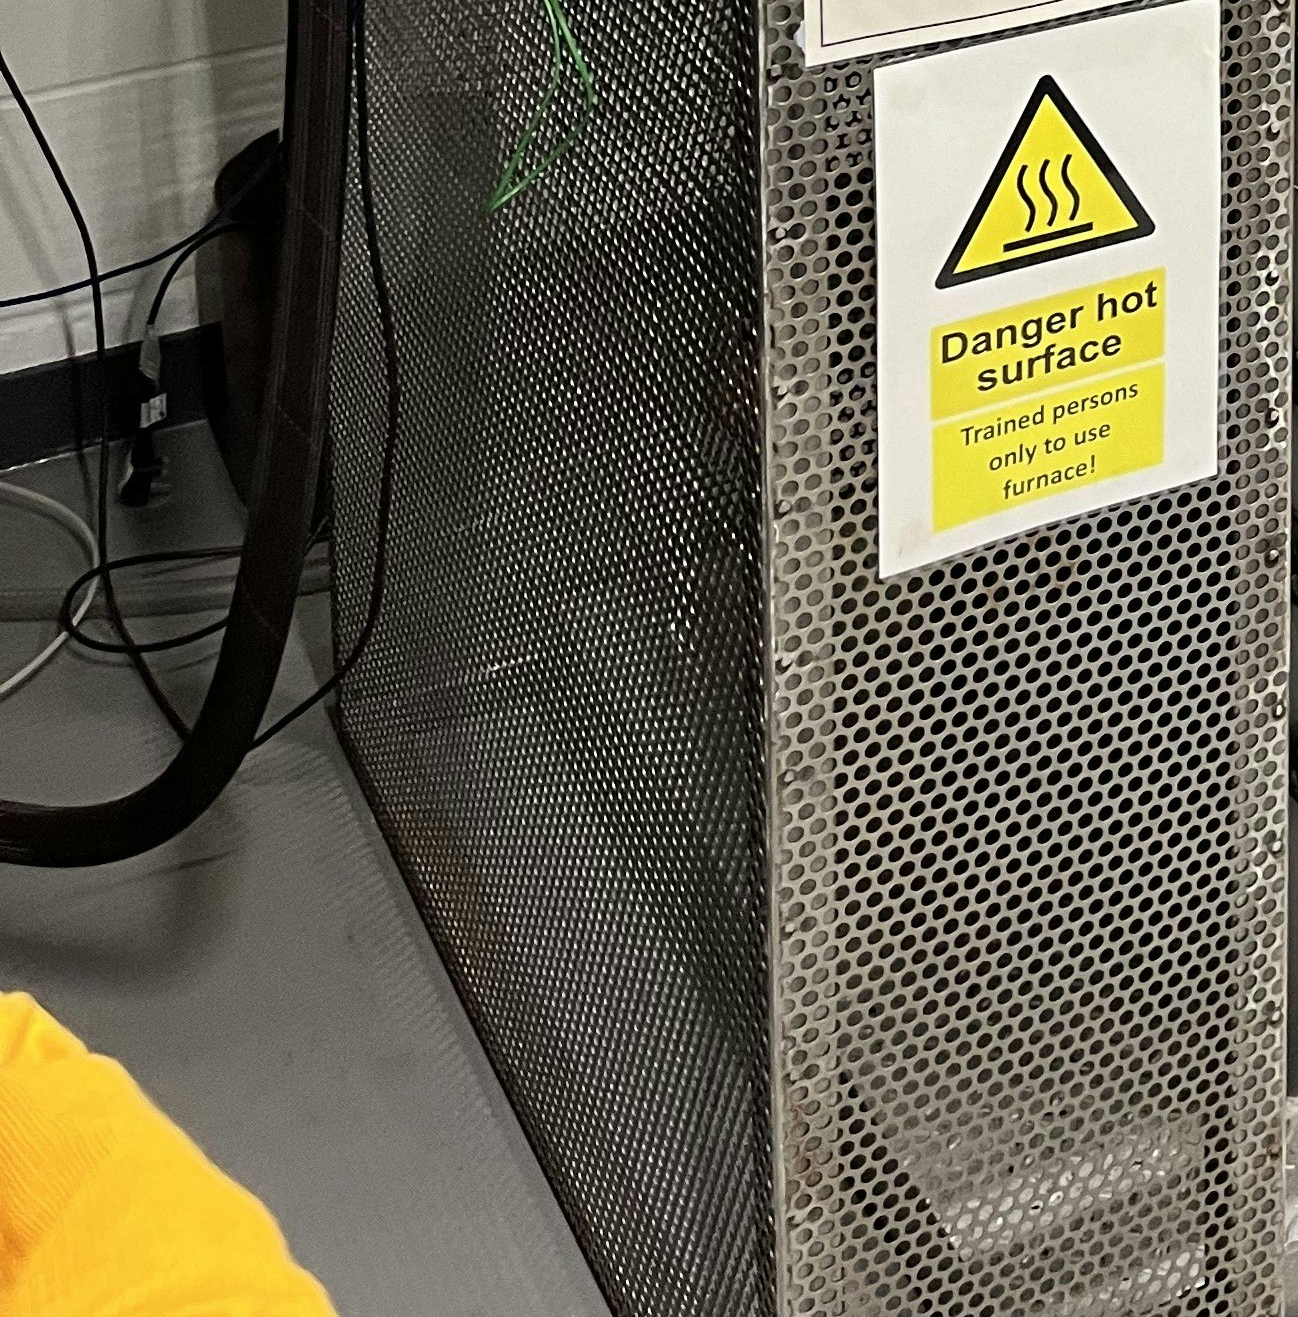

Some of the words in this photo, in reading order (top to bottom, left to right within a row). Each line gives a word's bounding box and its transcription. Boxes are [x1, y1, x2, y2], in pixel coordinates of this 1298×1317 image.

[941, 304, 1084, 365] Danger
[1097, 280, 1158, 323] hot
[976, 333, 1122, 392] surface
[960, 405, 1045, 447] Trained
[1052, 383, 1139, 425] persons
[988, 443, 1038, 471] only
[1044, 435, 1066, 455] to
[1074, 424, 1111, 446] use
[1003, 454, 1096, 500] furnace!
